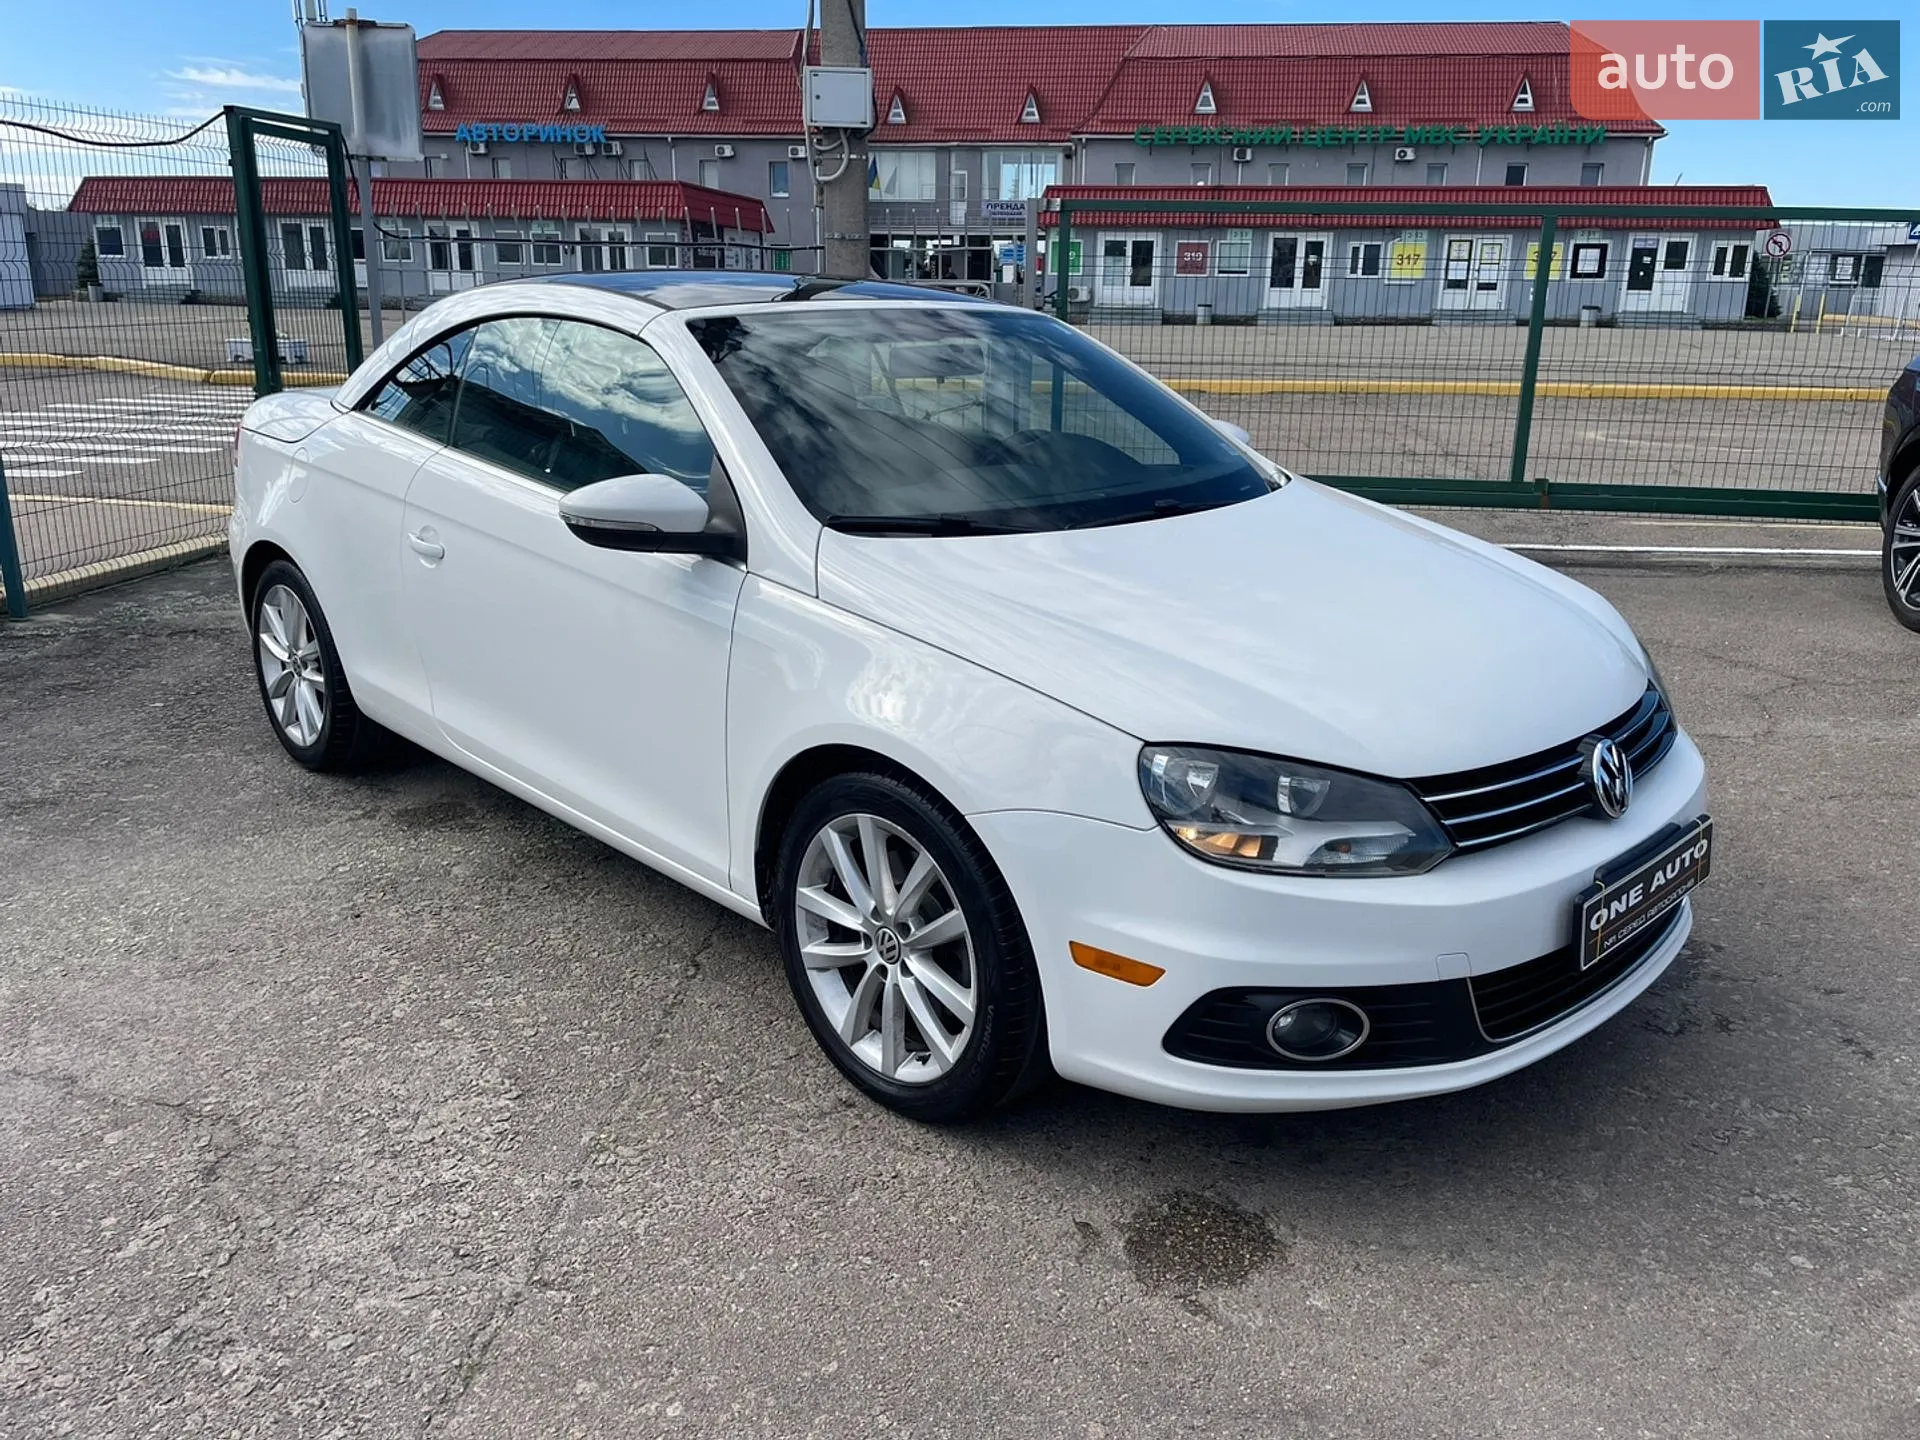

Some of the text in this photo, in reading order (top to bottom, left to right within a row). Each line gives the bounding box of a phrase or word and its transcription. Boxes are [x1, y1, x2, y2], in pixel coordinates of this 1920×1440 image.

[455, 122, 607, 144] АВТОРИНОК
[1134, 120, 1607, 148] СЕРВІСНИЙ ЦЕНТР МВС УКРАЇНИ
[1183, 251, 1203, 262] 319
[1396, 254, 1421, 266] 317
[1590, 882, 1644, 932] ONE
[1650, 838, 1709, 893] AUTO
